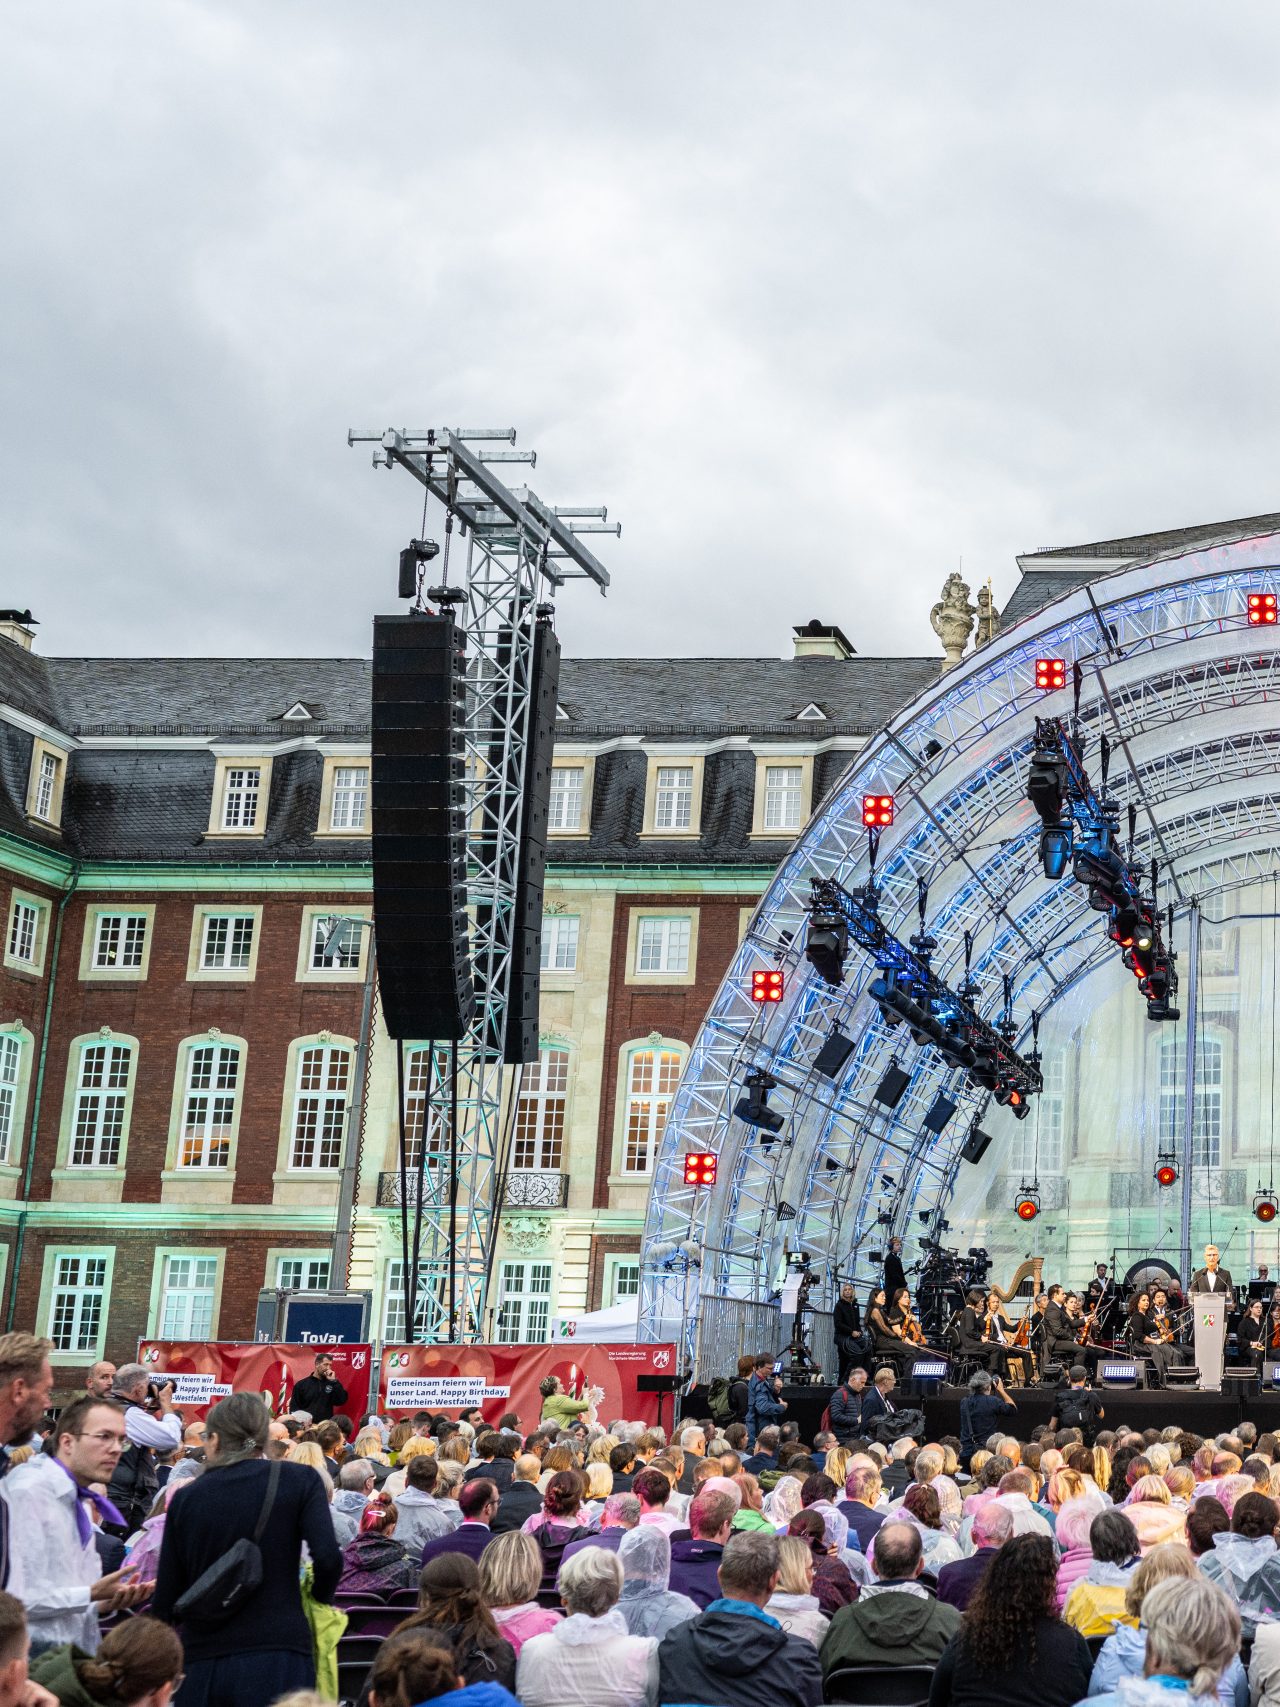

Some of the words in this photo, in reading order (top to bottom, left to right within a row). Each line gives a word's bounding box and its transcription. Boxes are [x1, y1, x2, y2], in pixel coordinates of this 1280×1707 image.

[390, 1379, 440, 1387] Gemeinsam
[442, 1378, 467, 1386] feiern
[469, 1378, 483, 1386] wir
[180, 1386, 199, 1394] Happy
[201, 1386, 230, 1395] Birthday,
[440, 1388, 467, 1398] Happy
[469, 1387, 508, 1397] Birthday,
[389, 1397, 480, 1406] Nordrhein-Westfalen.
